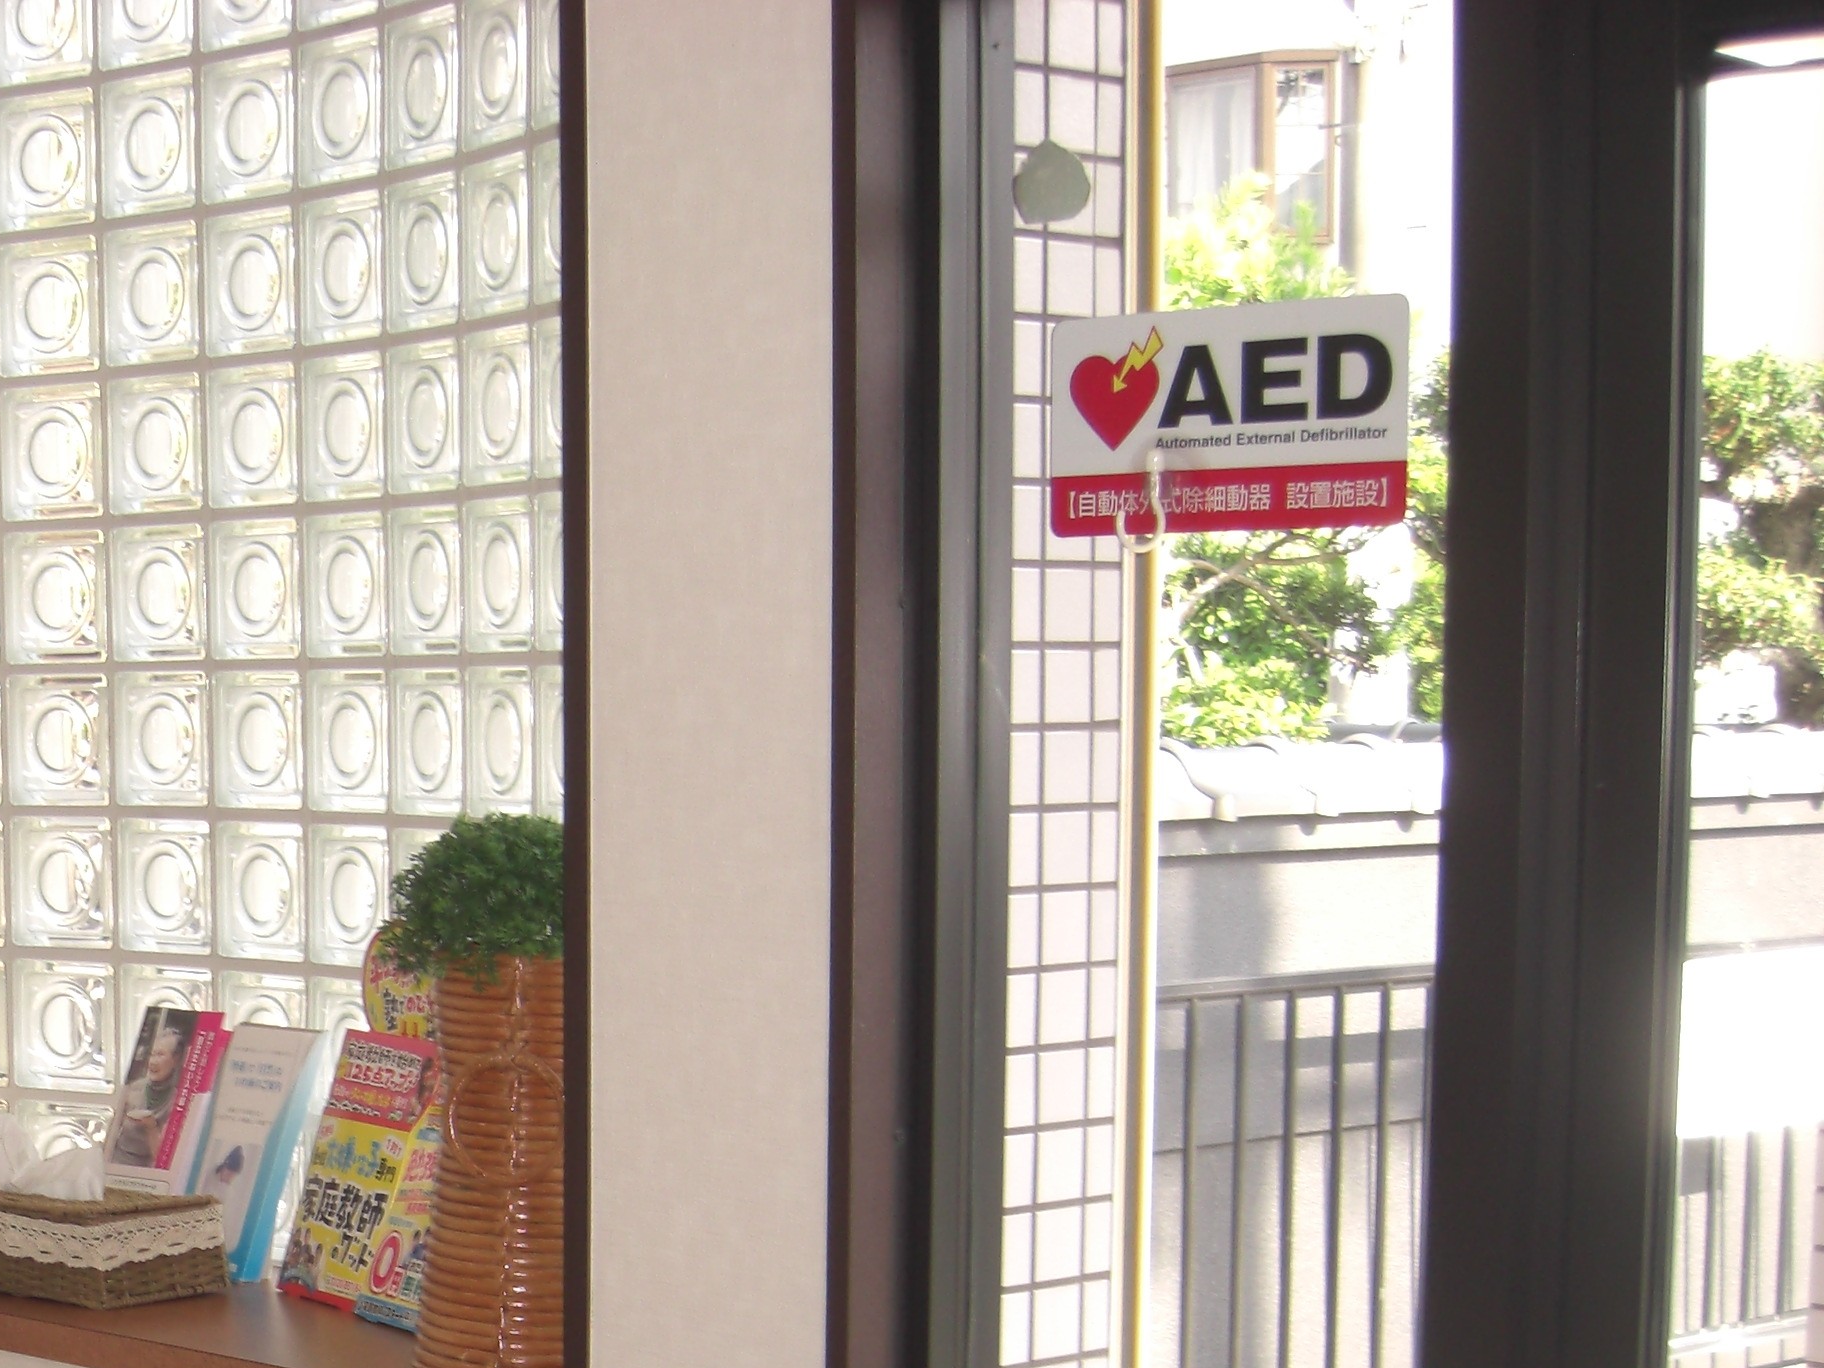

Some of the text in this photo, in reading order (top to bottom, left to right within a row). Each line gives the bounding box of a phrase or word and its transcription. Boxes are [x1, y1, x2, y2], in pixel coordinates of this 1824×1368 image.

[1157, 332, 1393, 430] AED
[1154, 426, 1388, 450] Automated External Defibrillator
[1285, 478, 1389, 511] 設置施設】
[301, 1172, 389, 1240] 家庭教師
[331, 1230, 375, 1273] のグッド
